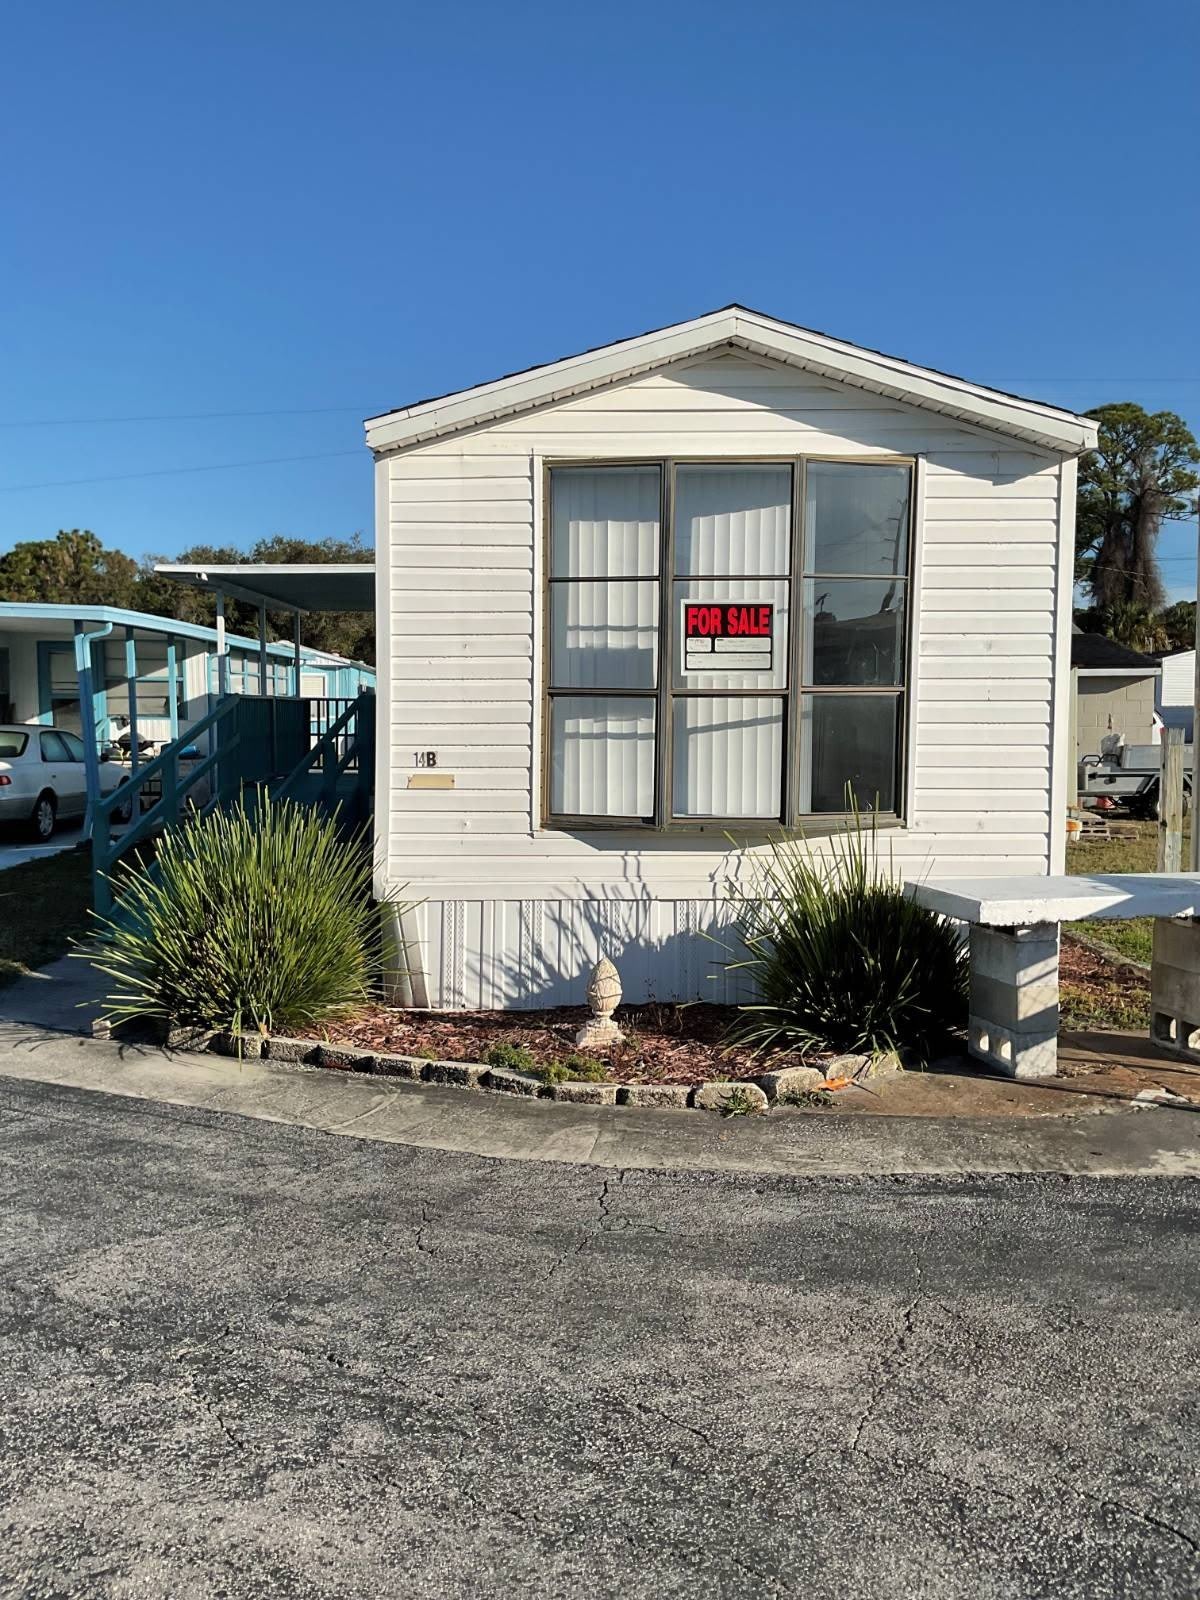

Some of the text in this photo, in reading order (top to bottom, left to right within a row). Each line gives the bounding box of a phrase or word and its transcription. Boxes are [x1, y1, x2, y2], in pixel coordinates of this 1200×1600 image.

[688, 607, 770, 635] FOR SALE
[413, 751, 437, 768] 14B
